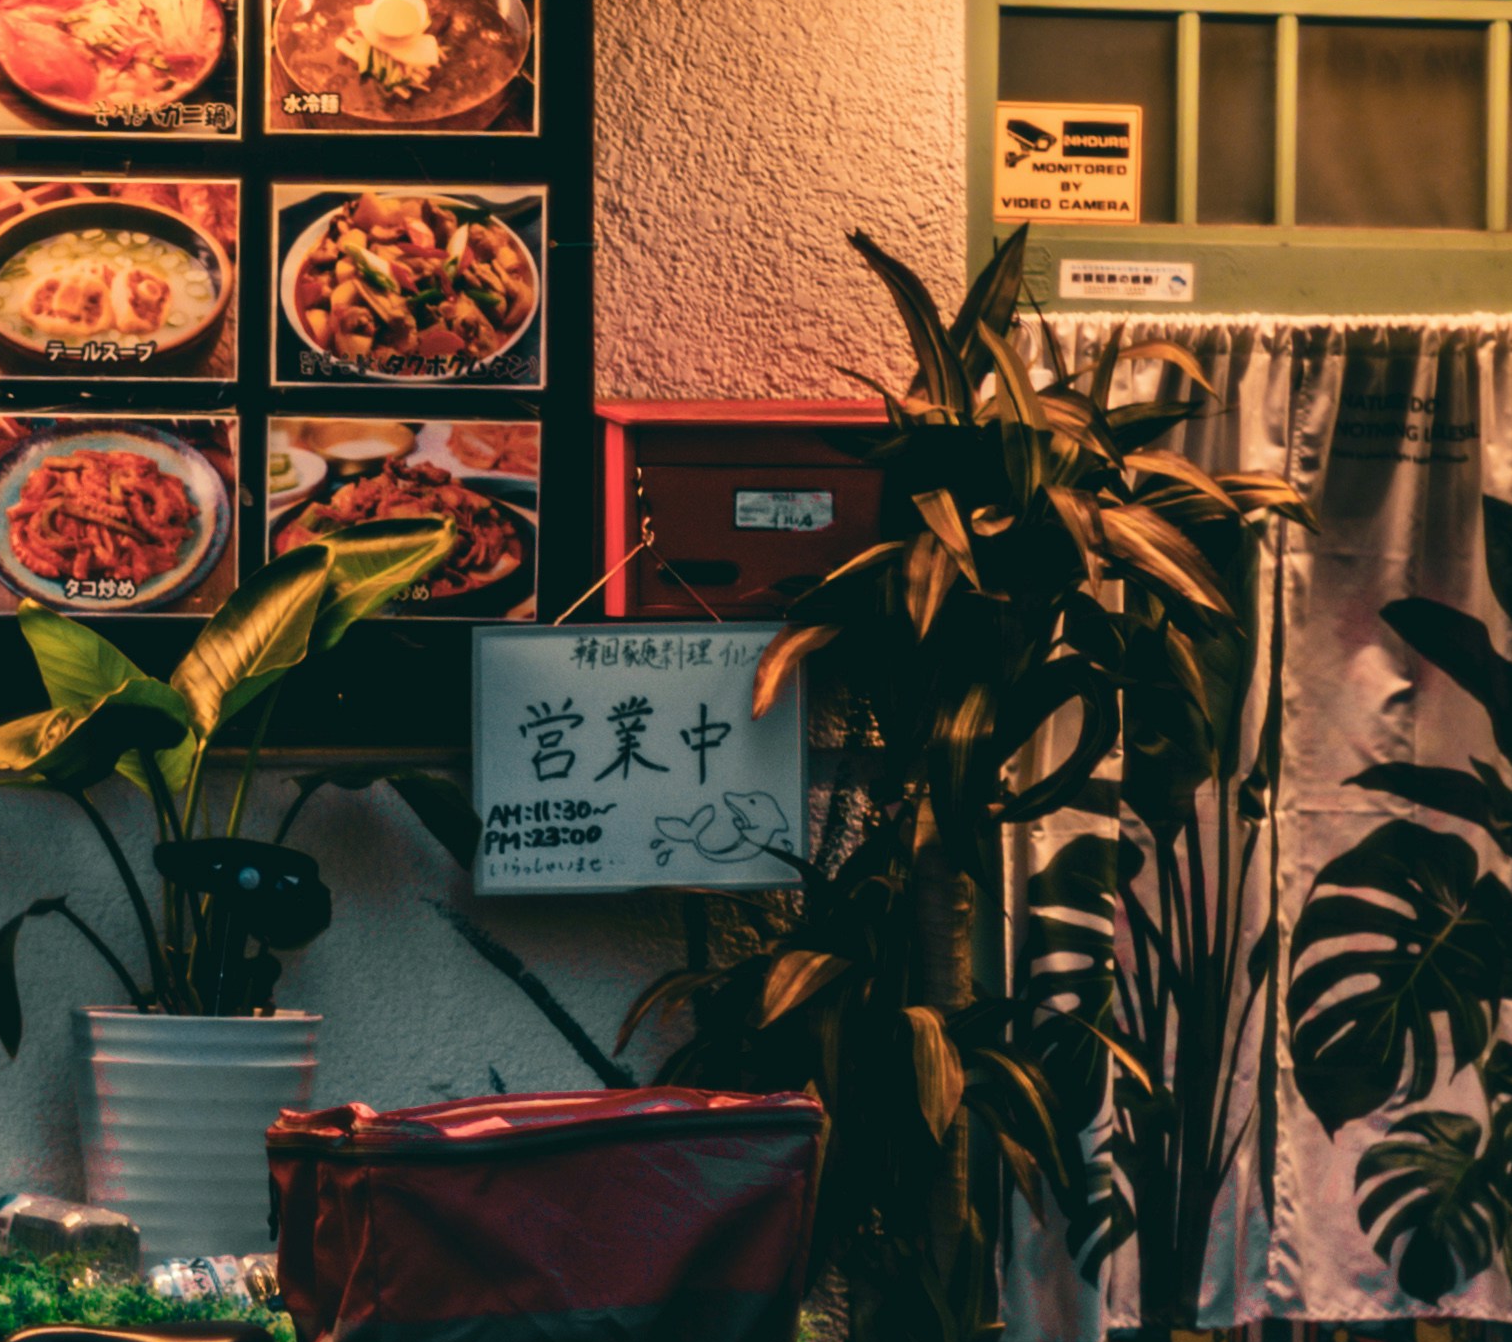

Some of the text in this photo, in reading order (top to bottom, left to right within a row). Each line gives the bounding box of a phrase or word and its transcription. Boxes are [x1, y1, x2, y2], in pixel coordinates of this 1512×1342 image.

[1031, 162, 1127, 176] MONITORED
[1060, 181, 1082, 193] BY
[1001, 197, 1130, 212] VIDEO CAMERA
[46, 339, 158, 363] テールスープ
[64, 578, 136, 599] タコ炒め
[519, 695, 732, 784] 営業中
[484, 825, 603, 855] PM:23:00
